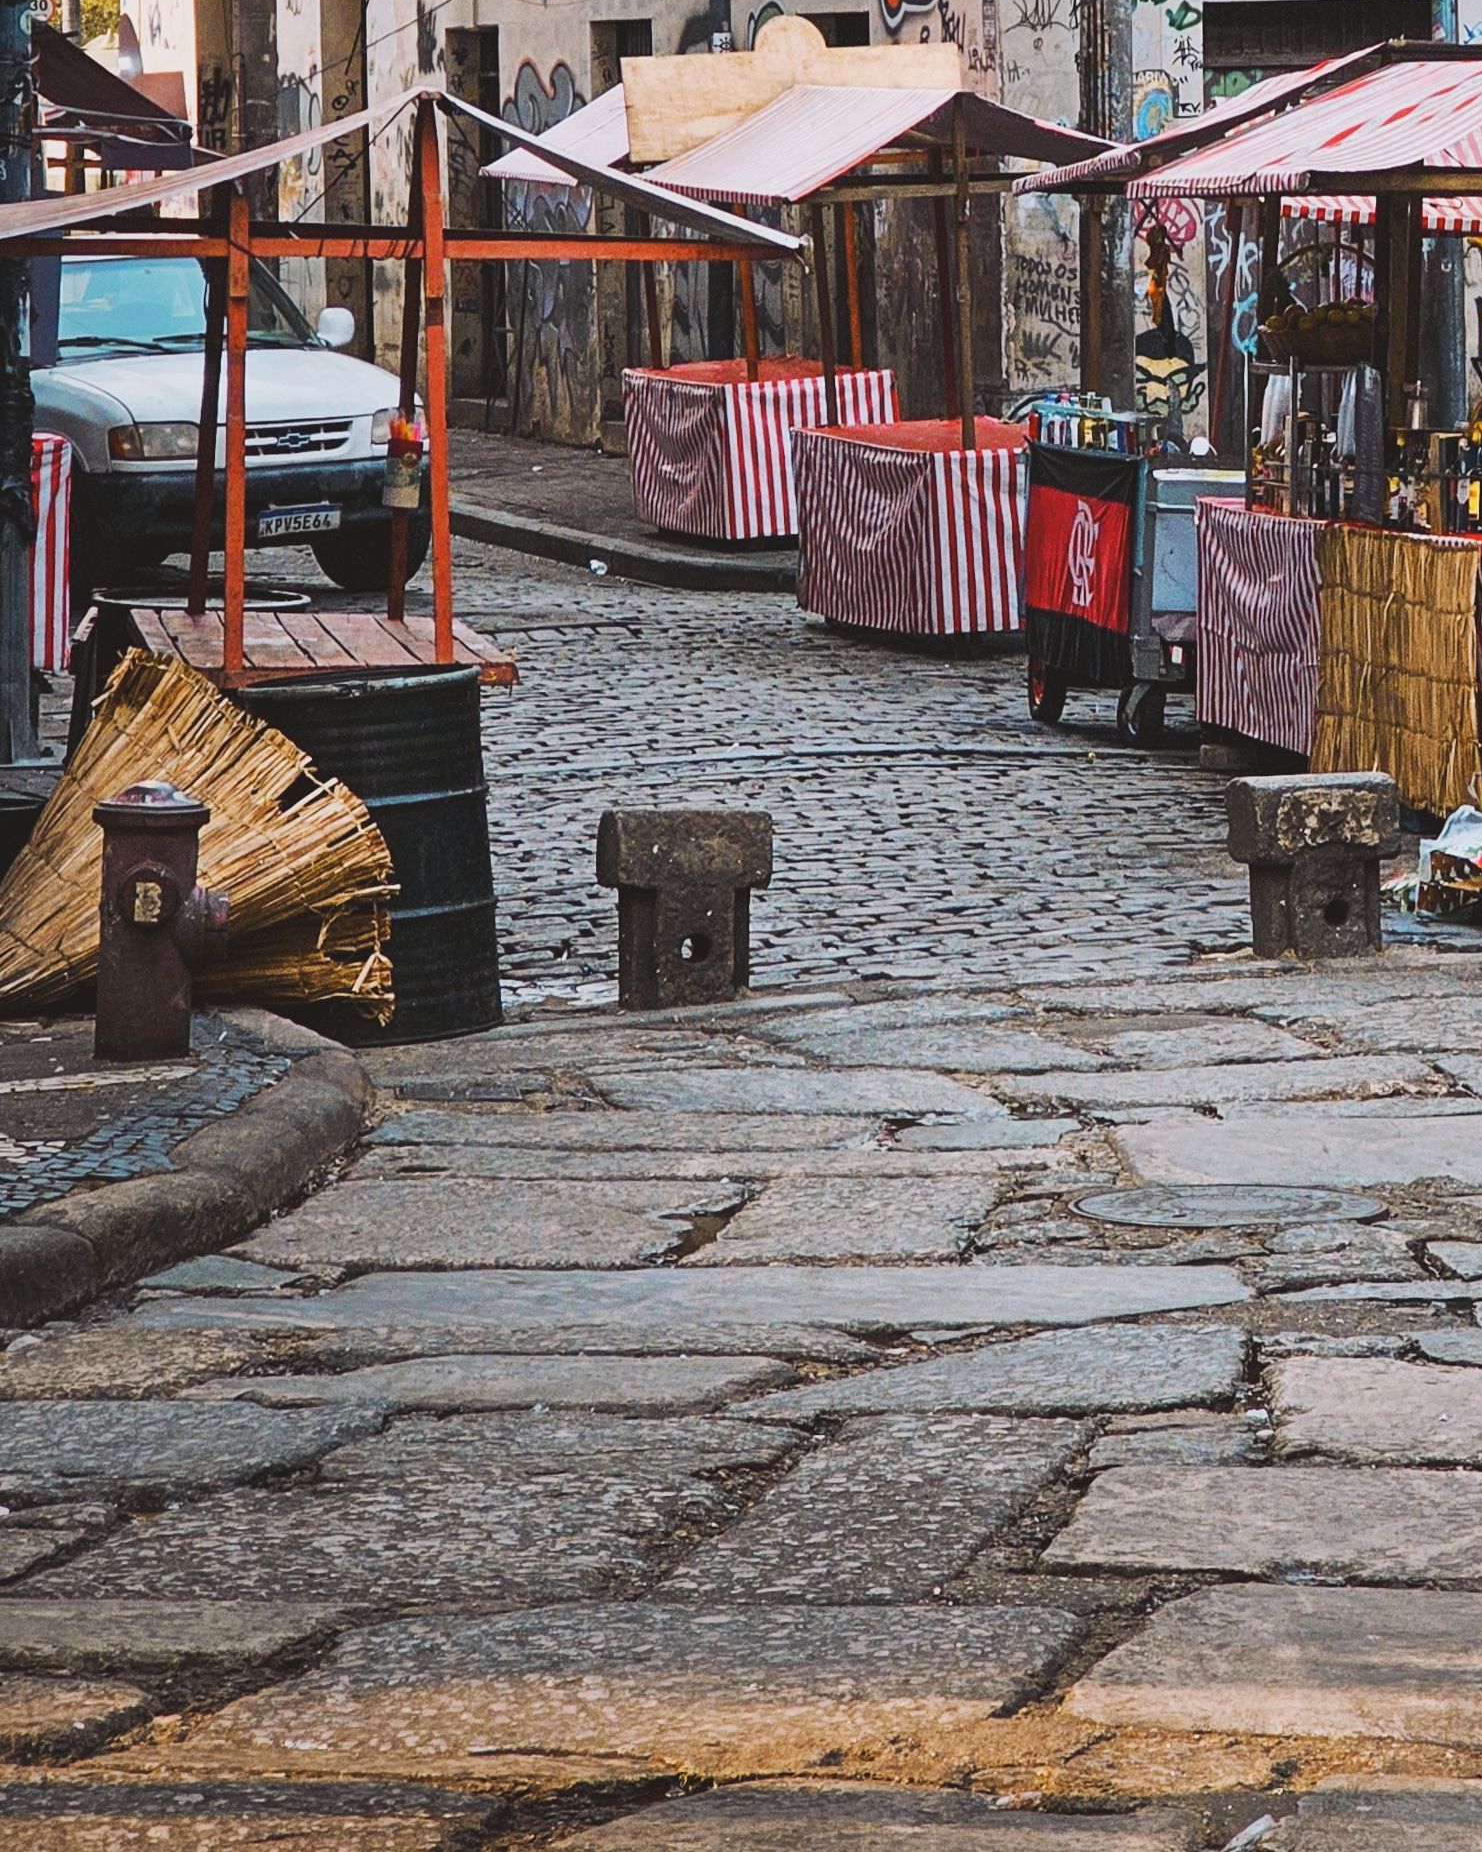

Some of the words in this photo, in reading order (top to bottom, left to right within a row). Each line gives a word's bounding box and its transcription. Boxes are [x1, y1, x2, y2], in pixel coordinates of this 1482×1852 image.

[30, 0, 48, 11] 30
[1054, 263, 1078, 281] OS
[265, 514, 331, 535] KPV5E64
